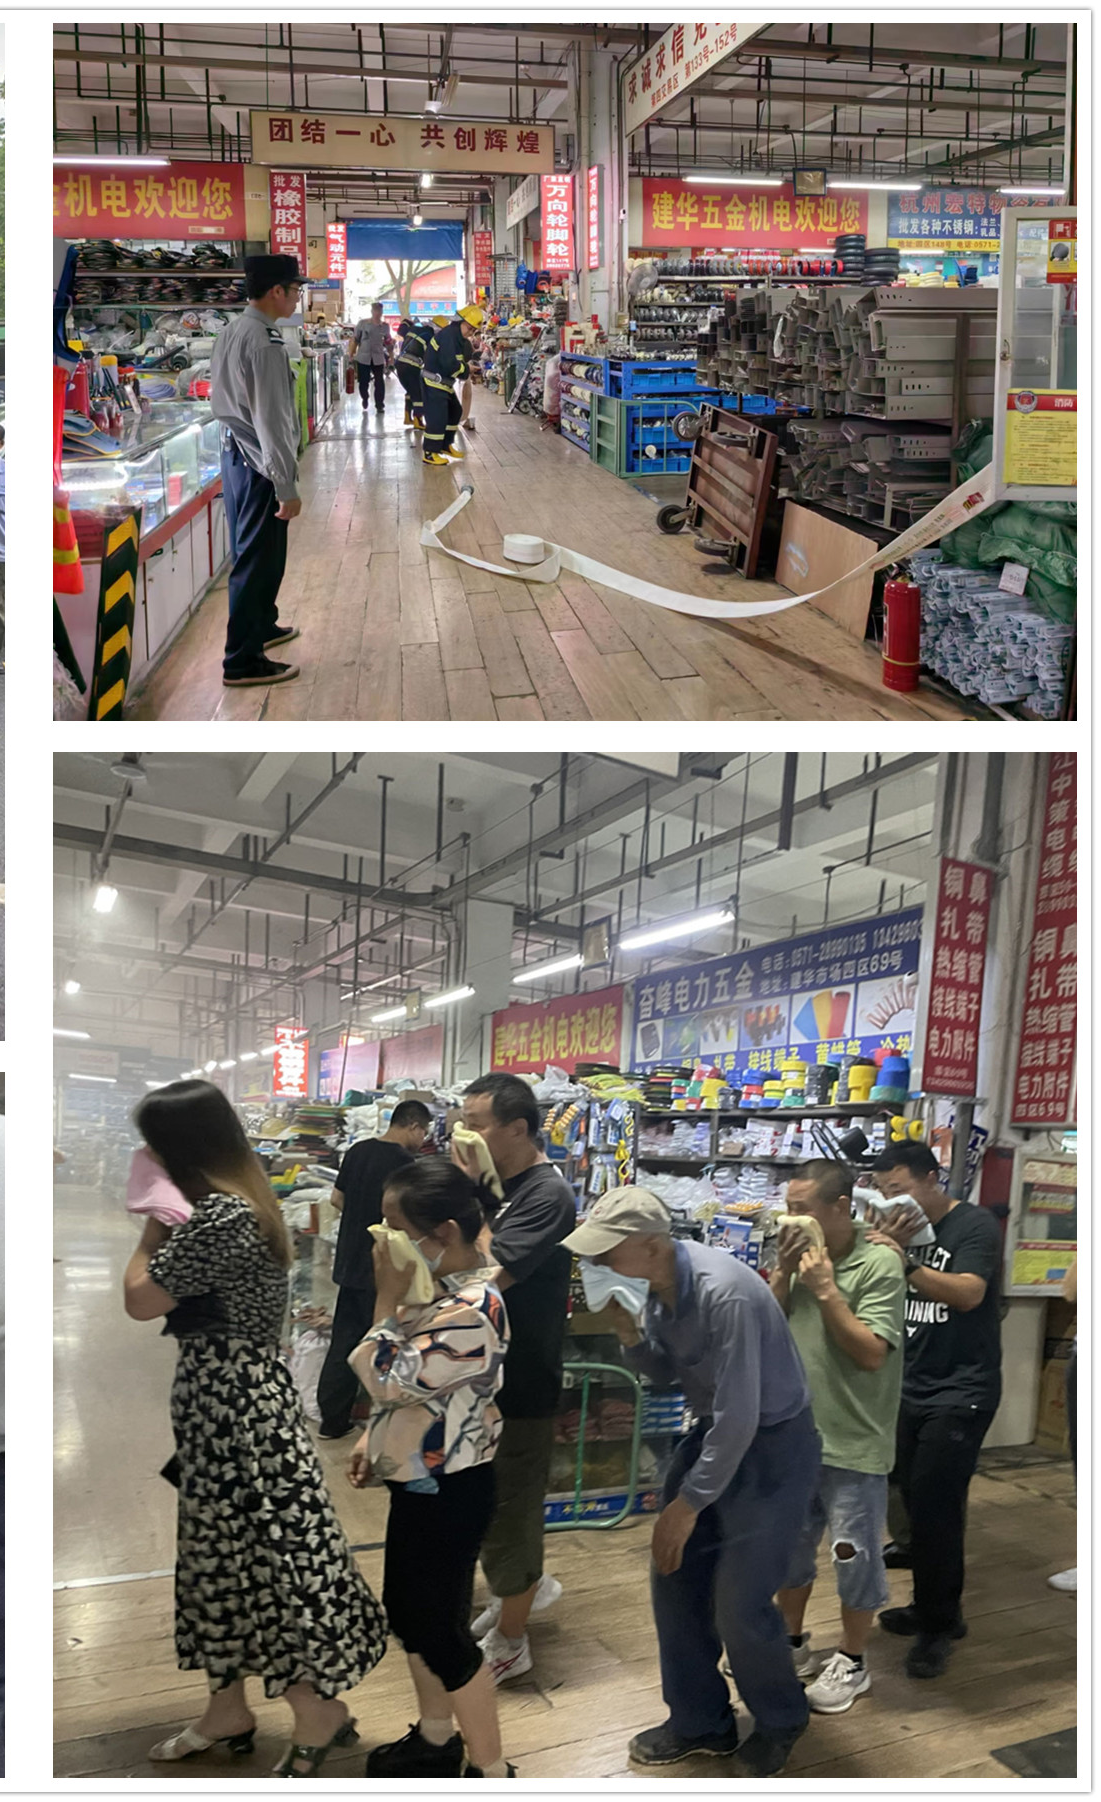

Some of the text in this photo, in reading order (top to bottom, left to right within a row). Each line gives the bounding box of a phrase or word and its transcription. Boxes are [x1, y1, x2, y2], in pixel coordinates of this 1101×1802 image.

[269, 118, 541, 154] 团结一心 共创辉煌
[273, 175, 301, 187] 批发
[546, 184, 569, 256] 万向轮脚轮
[652, 190, 861, 233] 建华五金机电欢迎您
[494, 1002, 618, 1066] 建华五金机电欢迎您
